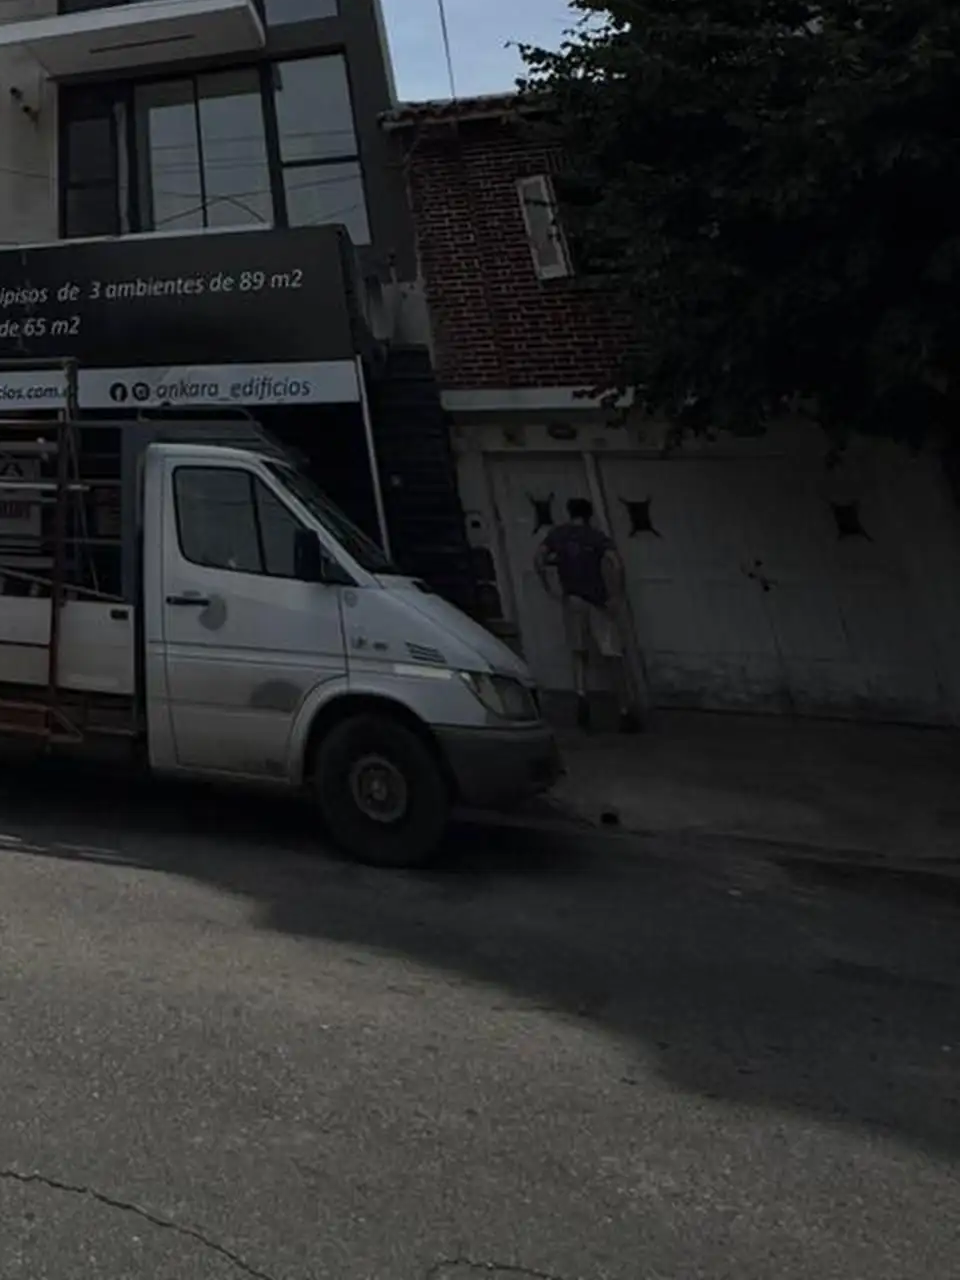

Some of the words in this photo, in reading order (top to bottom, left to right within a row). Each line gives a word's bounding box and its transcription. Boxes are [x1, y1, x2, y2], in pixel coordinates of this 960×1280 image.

[57, 282, 81, 302] de
[88, 280, 101, 299] 3
[104, 274, 206, 298] ambientes
[209, 272, 234, 293] de
[238, 271, 265, 291] 89
[269, 268, 304, 289] m2
[22, 317, 46, 337] 65
[49, 315, 81, 336] m2
[156, 375, 311, 401] ankara_edificios
